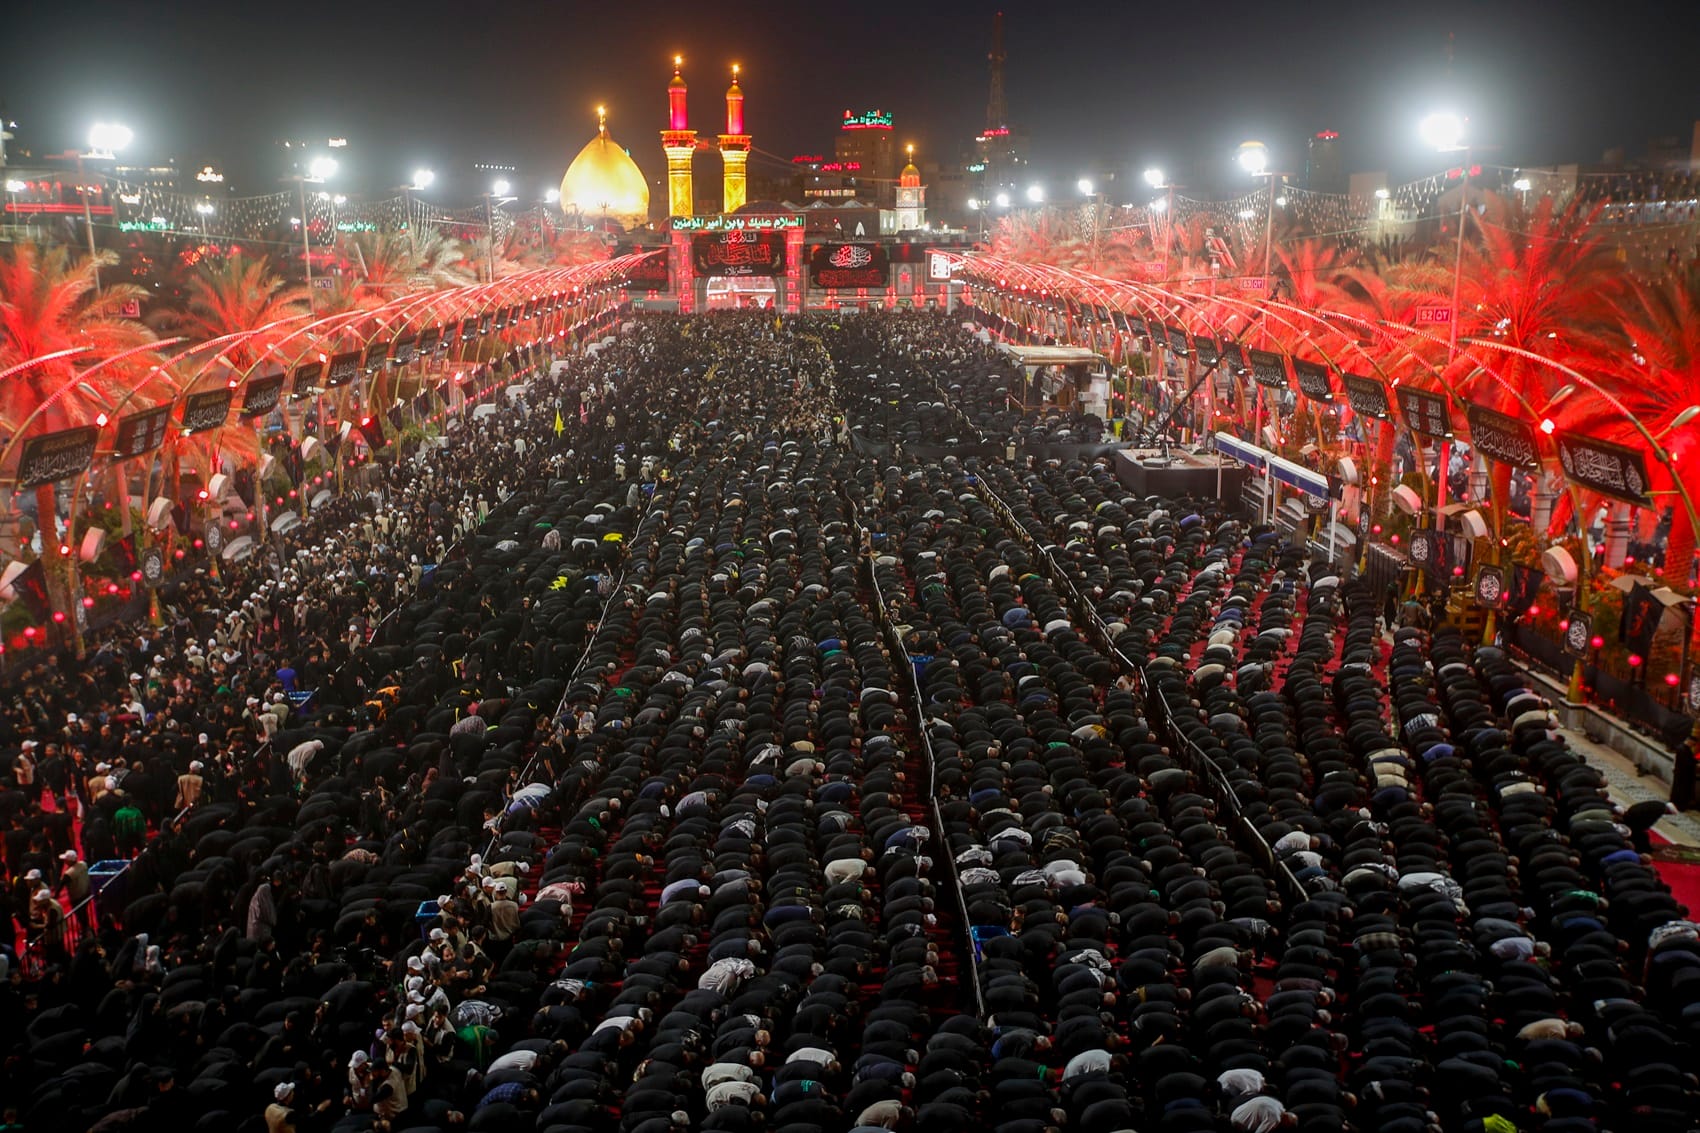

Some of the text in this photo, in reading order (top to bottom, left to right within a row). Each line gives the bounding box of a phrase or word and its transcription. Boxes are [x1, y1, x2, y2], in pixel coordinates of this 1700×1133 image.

[672, 215, 803, 230] السلام عليك يابن أمير المؤمنين
[1421, 310, 1433, 320] 52
[1436, 310, 1448, 320] ٥٢
